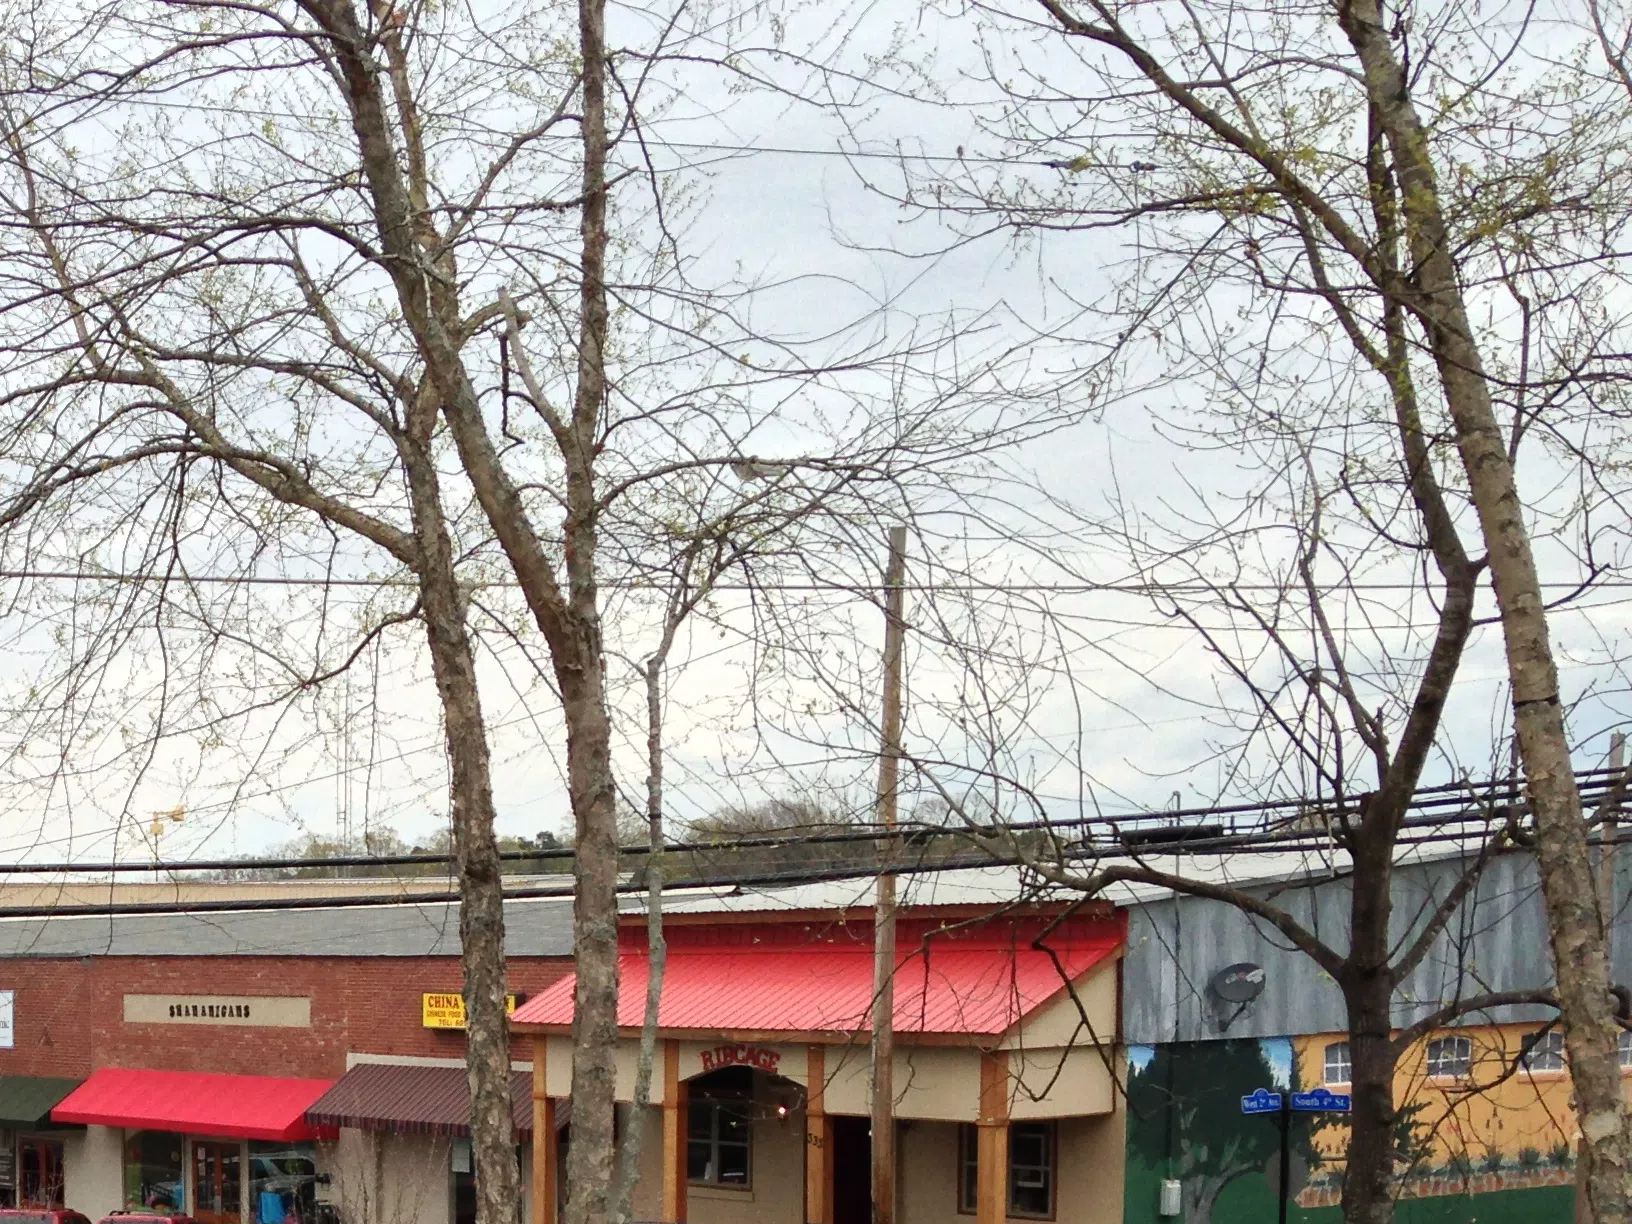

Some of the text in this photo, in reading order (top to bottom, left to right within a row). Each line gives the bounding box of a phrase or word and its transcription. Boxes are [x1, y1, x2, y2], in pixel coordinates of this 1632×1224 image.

[428, 995, 460, 1009] CHINA
[700, 1044, 781, 1073] RIBCAGE
[1295, 1097, 1320, 1106] South
